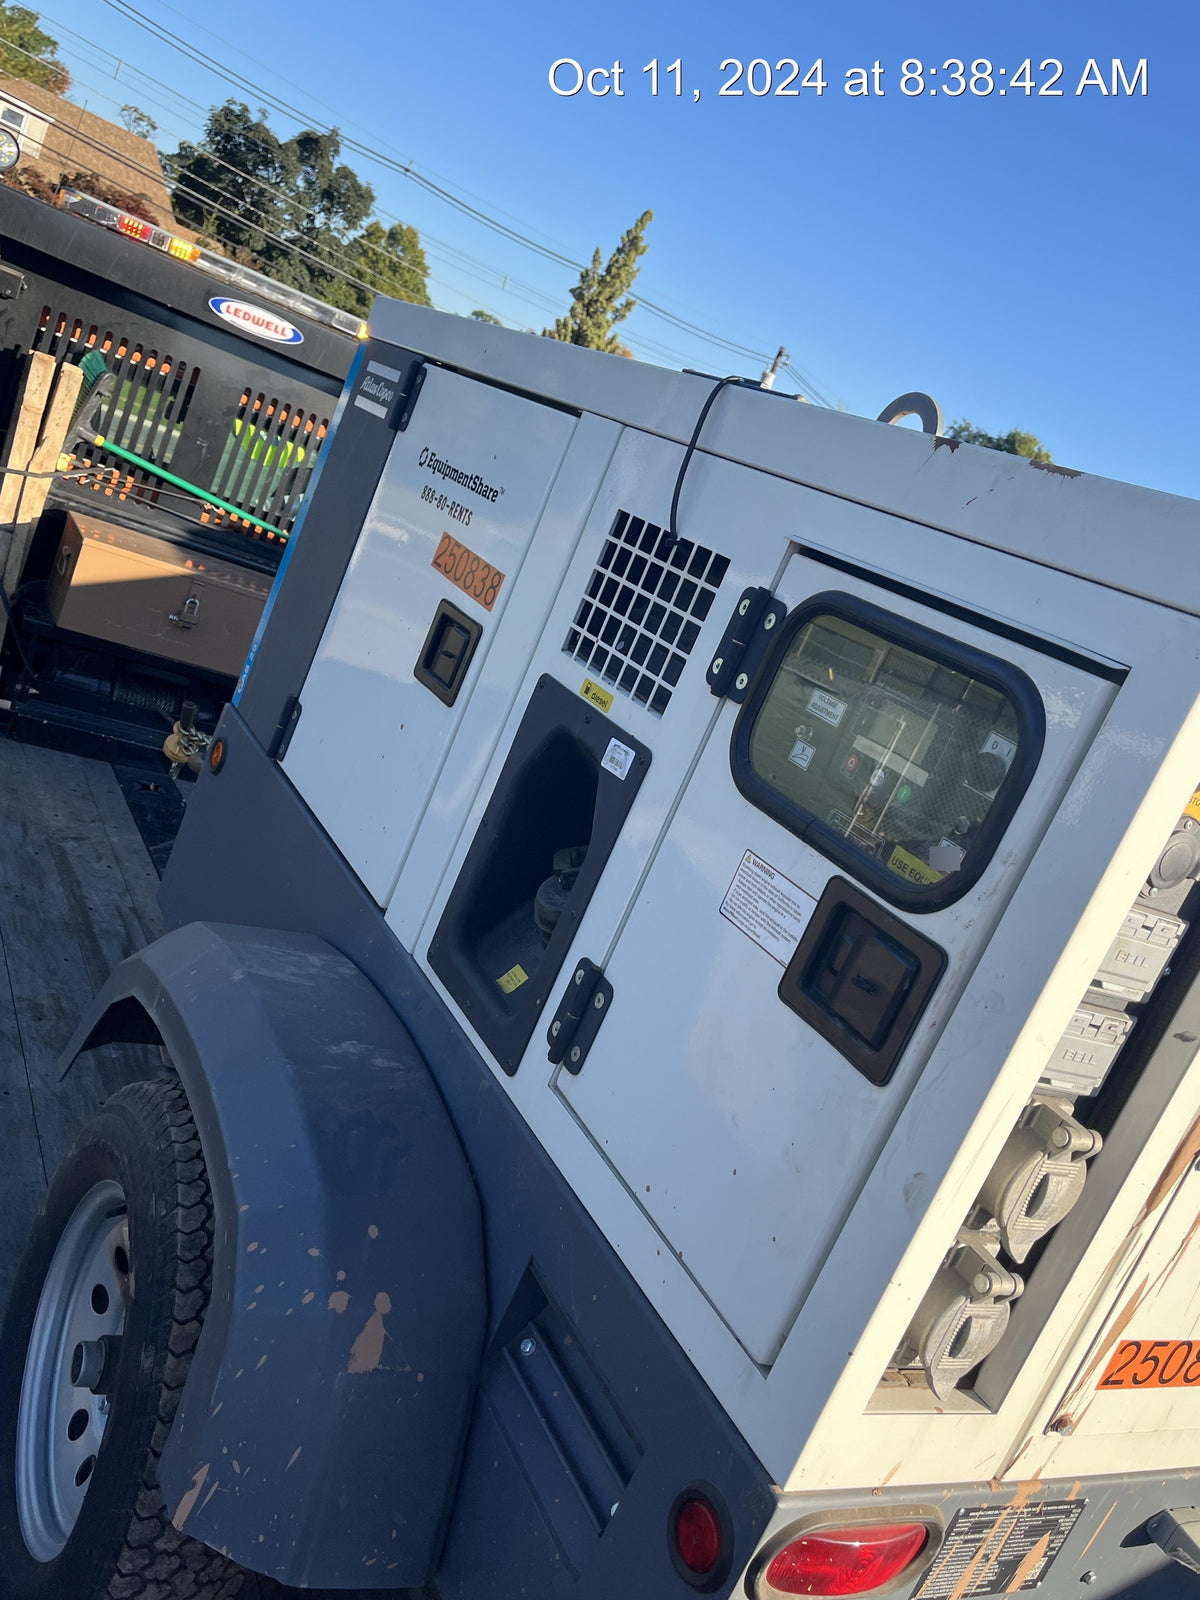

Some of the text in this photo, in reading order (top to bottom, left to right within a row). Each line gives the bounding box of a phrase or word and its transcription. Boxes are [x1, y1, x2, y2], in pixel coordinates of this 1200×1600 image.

[225, 304, 287, 337] LEDWELL
[426, 451, 499, 503] EquipmentShare
[420, 485, 473, 527] 888-80-RENTS
[434, 535, 502, 607] 250838
[591, 692, 609, 709] diesel
[810, 702, 840, 721] ADJUSTMENT
[752, 858, 776, 880] WARNING
[891, 855, 909, 873] USE
[1062, 1049, 1096, 1066] BELL
